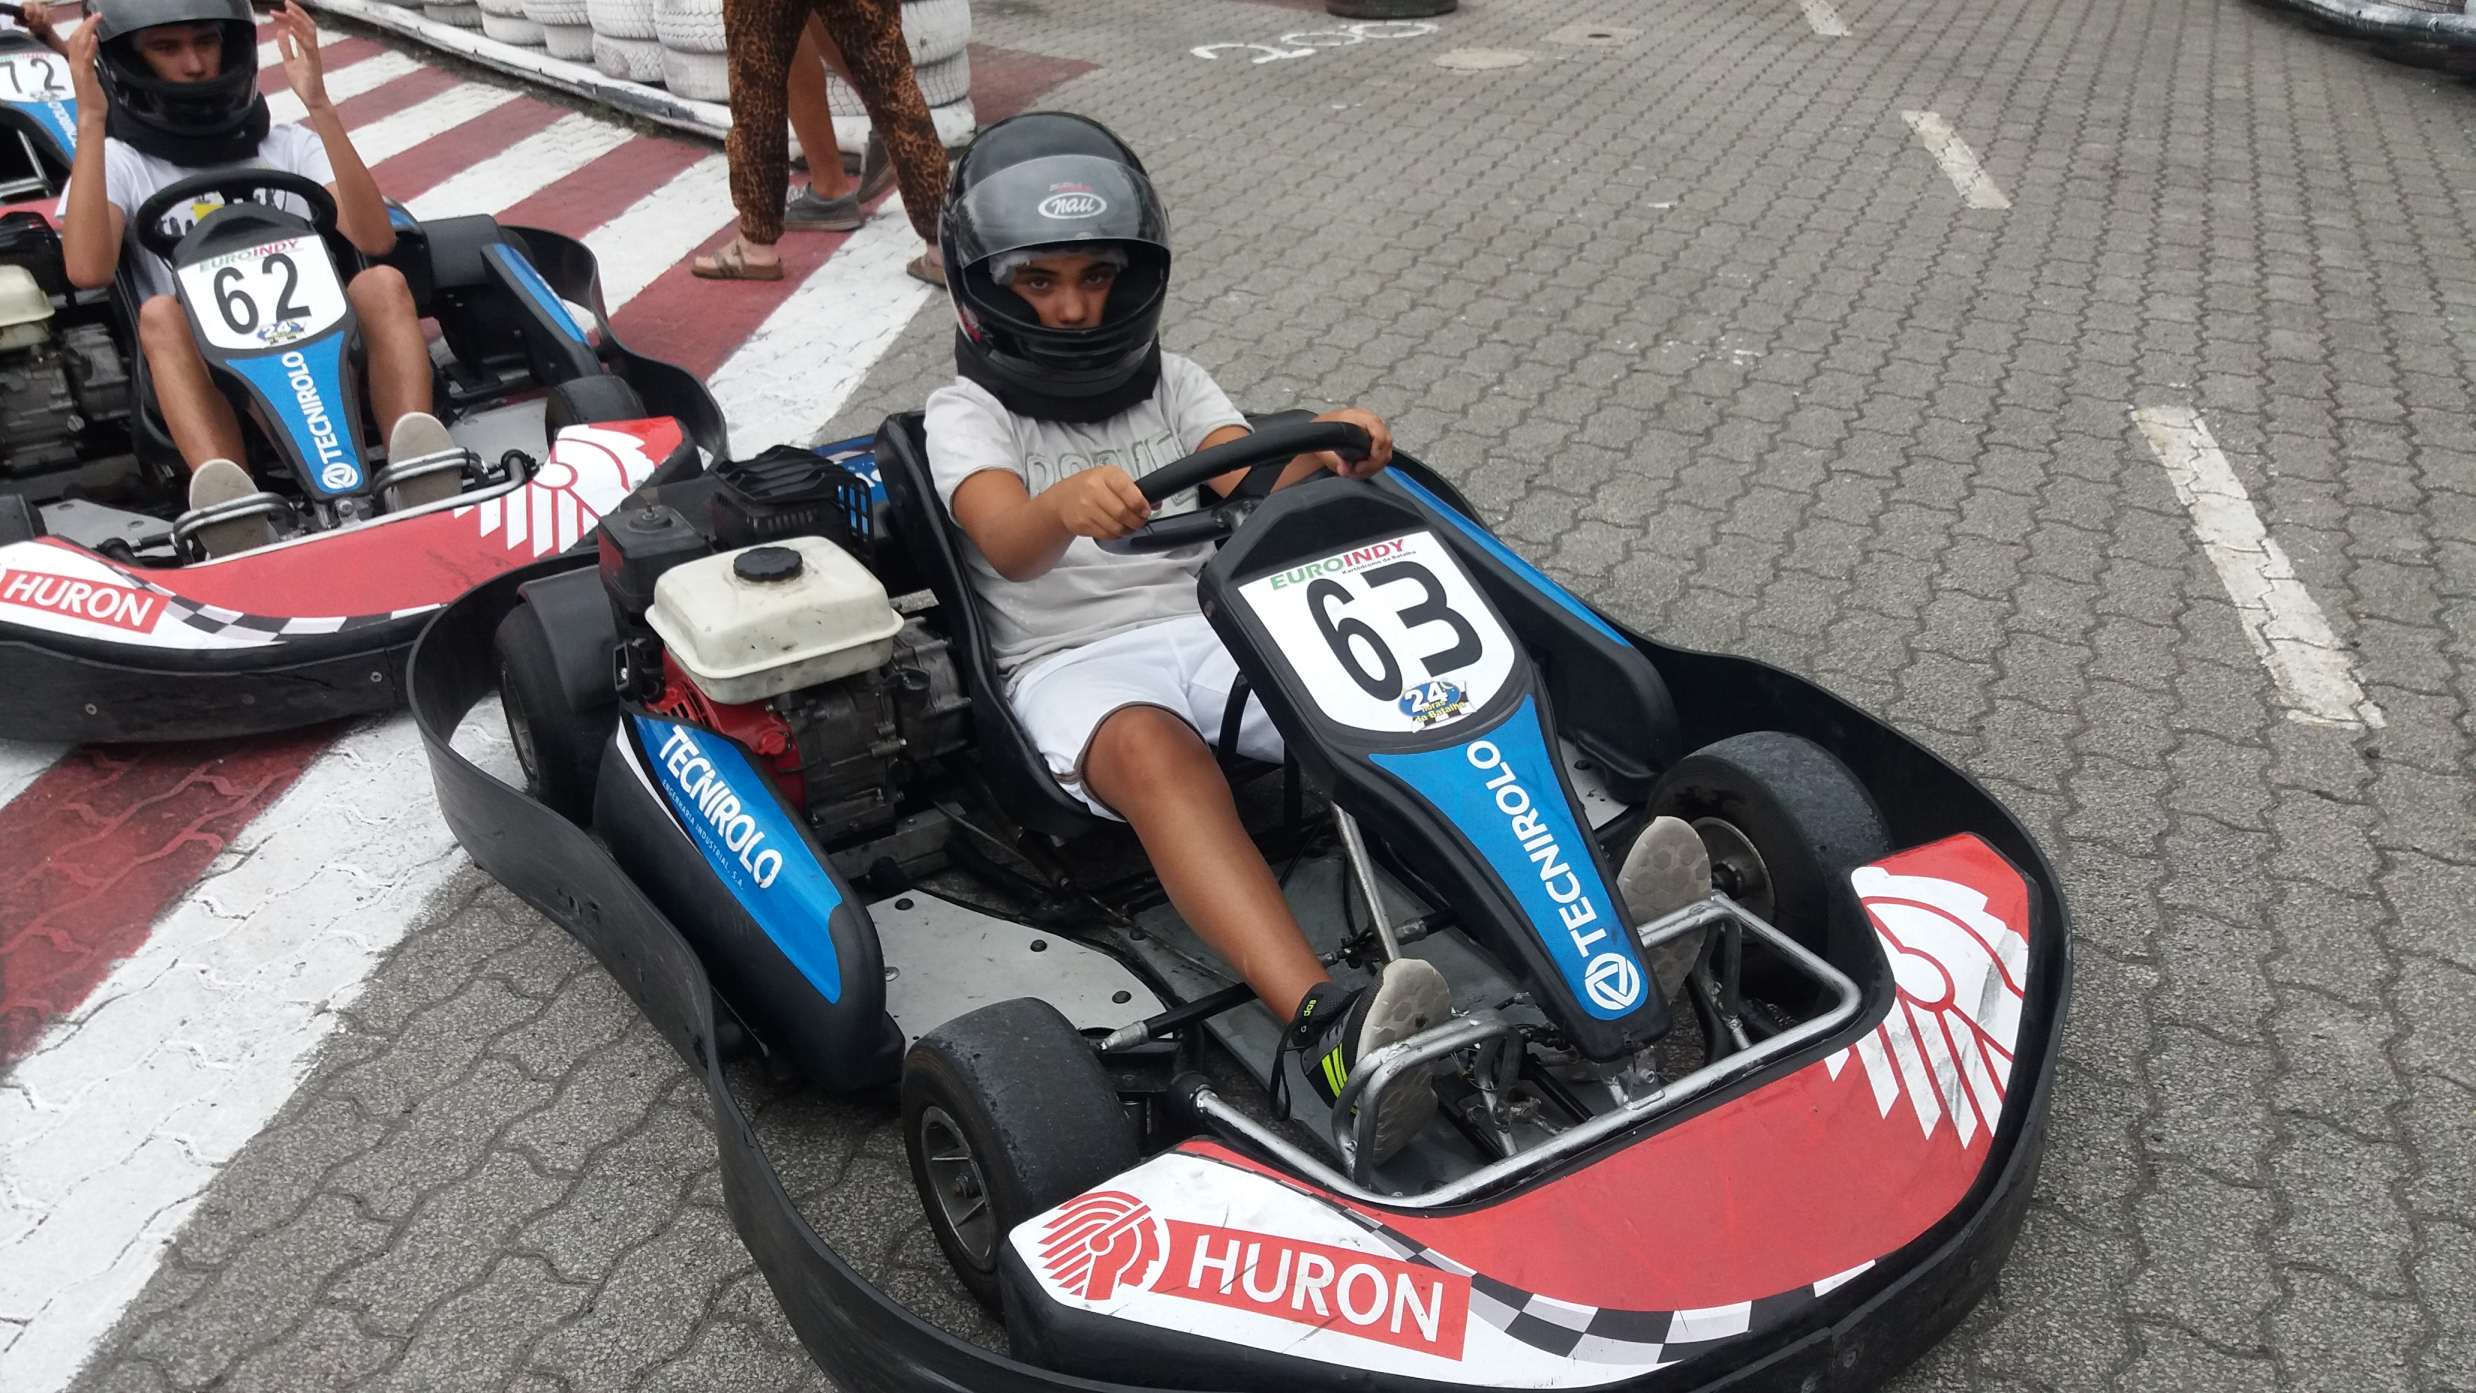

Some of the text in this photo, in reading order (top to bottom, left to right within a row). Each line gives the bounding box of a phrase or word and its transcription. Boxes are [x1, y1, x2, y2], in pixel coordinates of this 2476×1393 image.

[0, 58, 66, 94] 72
[200, 239, 300, 271] EUROINDY
[213, 253, 312, 335] 62
[281, 351, 343, 464] TECNIROLO
[3, 573, 154, 627] HURON
[1270, 539, 1405, 591] EUROINDY
[1306, 560, 1483, 702] 63
[1404, 682, 1449, 713] 24
[658, 724, 784, 888] TECNIROLO
[1466, 740, 1608, 958] TECNIROLO
[1187, 1234, 1443, 1342] HURON
